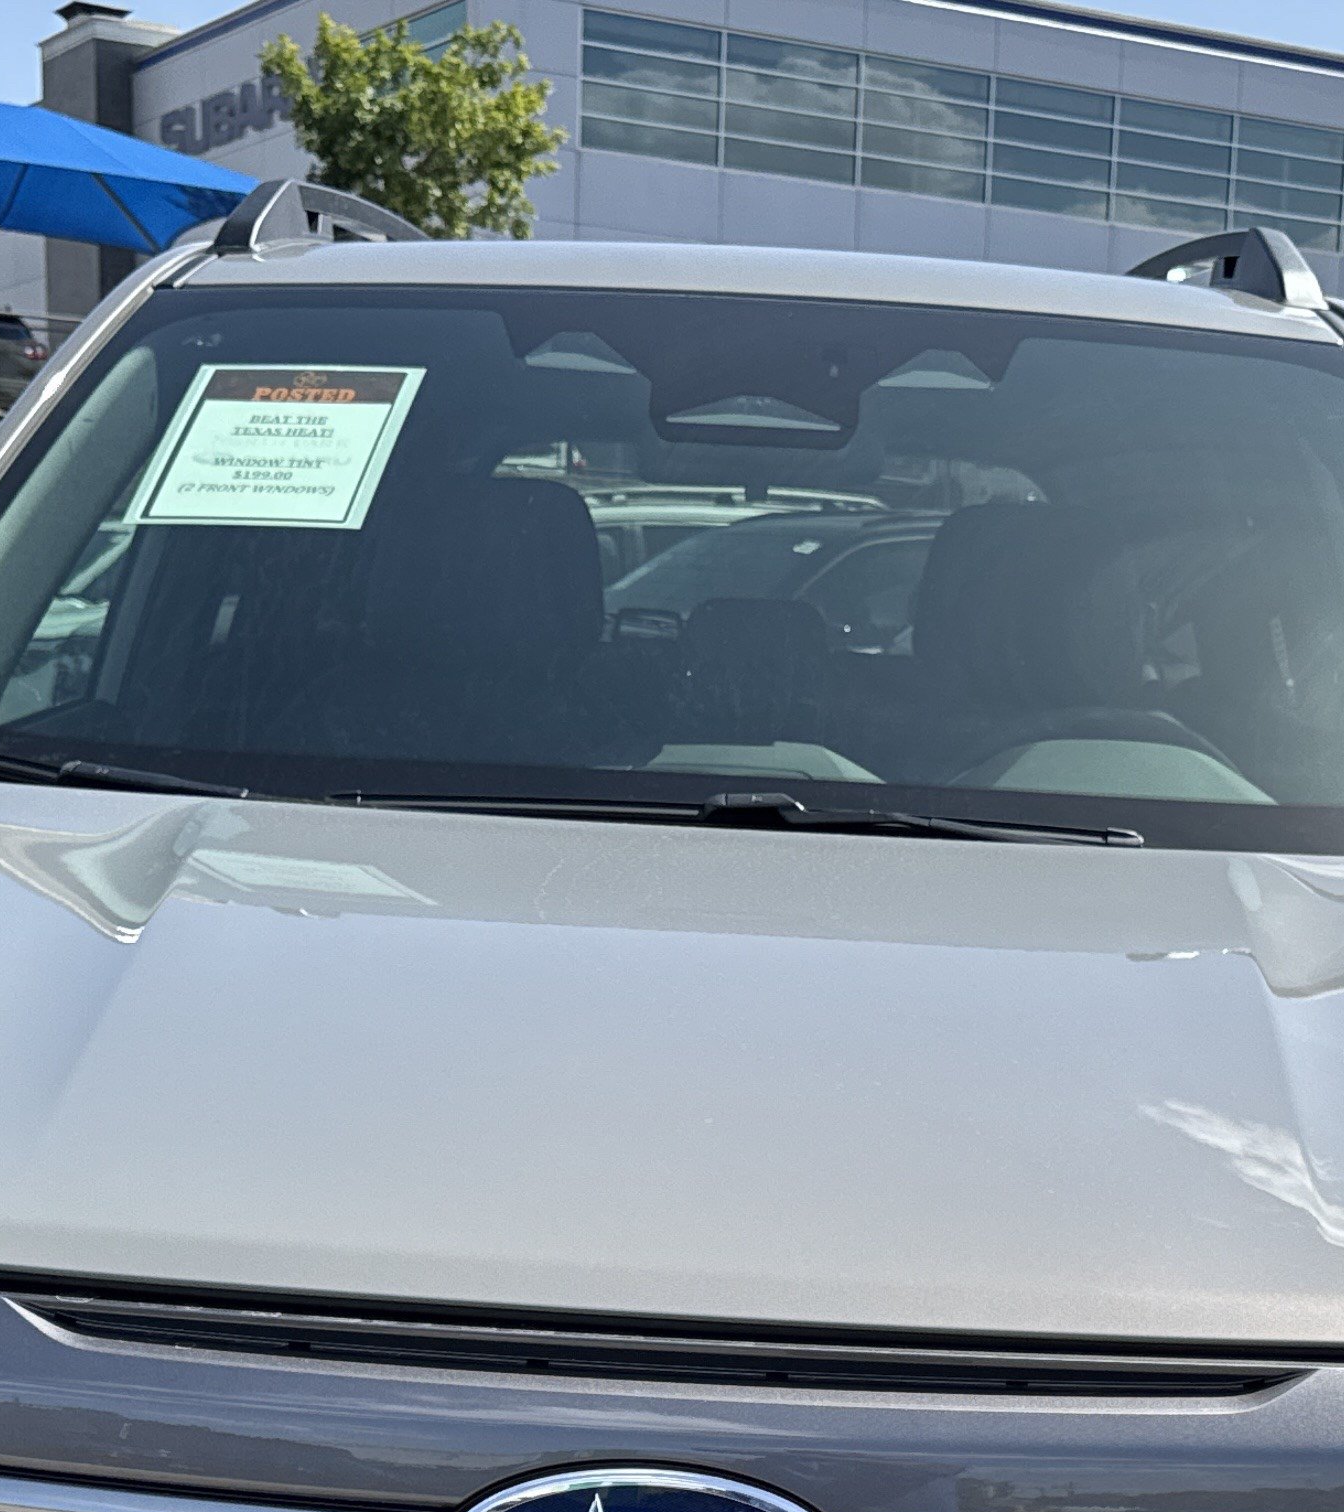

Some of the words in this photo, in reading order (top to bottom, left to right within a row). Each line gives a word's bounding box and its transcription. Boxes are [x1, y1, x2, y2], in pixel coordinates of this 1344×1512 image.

[160, 64, 316, 155] SUBAR
[253, 387, 356, 402] POSTED
[249, 415, 293, 425] BEAT
[295, 416, 328, 425] THE
[231, 427, 282, 437] TEXAS
[285, 428, 334, 438] HEAT!
[213, 457, 283, 468] WINDOW
[286, 459, 325, 469] TINT
[232, 470, 293, 480] $199.00
[197, 484, 250, 493] FRONT
[252, 485, 335, 496] WINDOWS)
